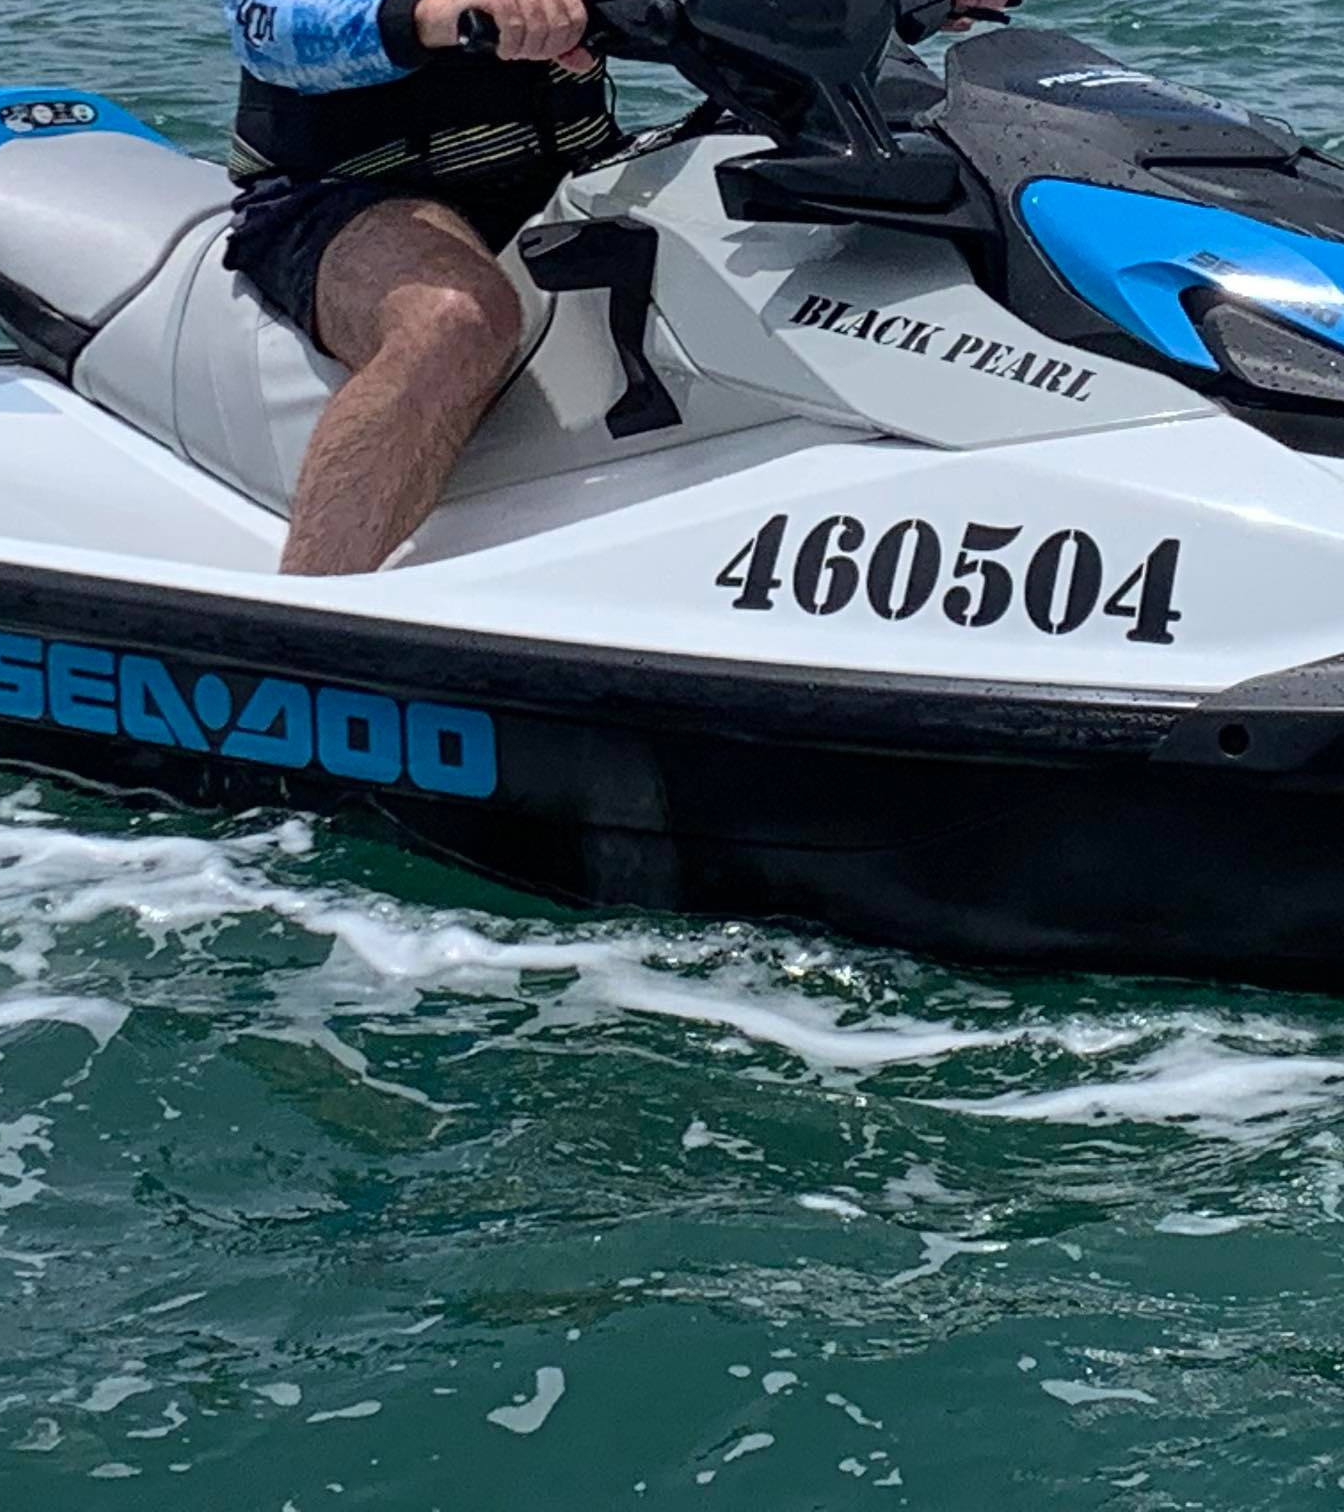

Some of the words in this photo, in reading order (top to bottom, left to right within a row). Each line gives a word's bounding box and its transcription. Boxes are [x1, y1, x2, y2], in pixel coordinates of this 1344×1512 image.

[788, 293, 945, 355] BLACK
[940, 333, 1098, 402] PEARL
[715, 514, 1183, 645] 460504
